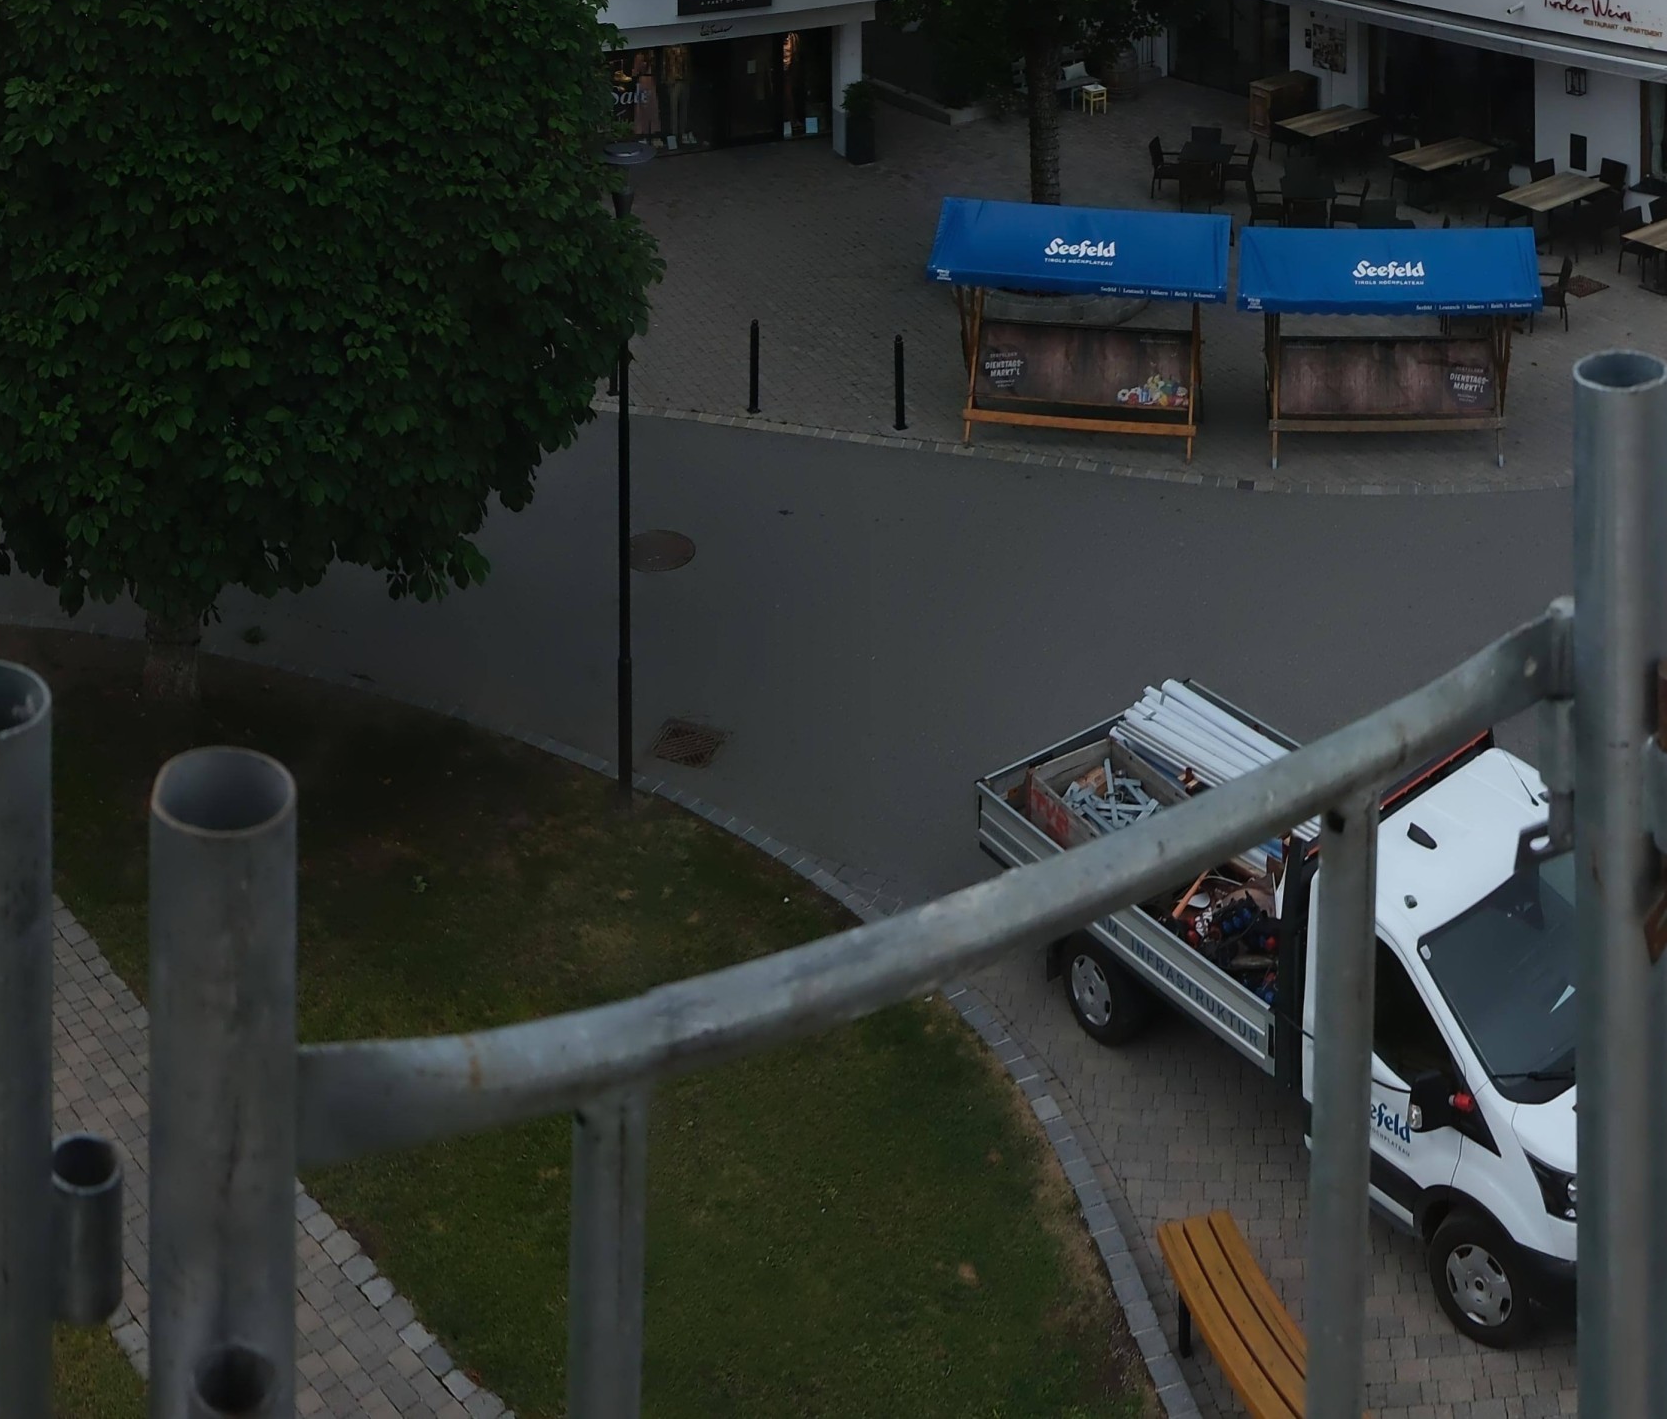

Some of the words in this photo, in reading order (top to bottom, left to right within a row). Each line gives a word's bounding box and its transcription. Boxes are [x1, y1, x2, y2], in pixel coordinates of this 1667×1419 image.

[1044, 236, 1116, 258] Seefeld
[1353, 260, 1425, 279] Seefeld
[1128, 937, 1262, 1049] INFRASTRUKTUR
[1370, 1102, 1411, 1143] efeld
